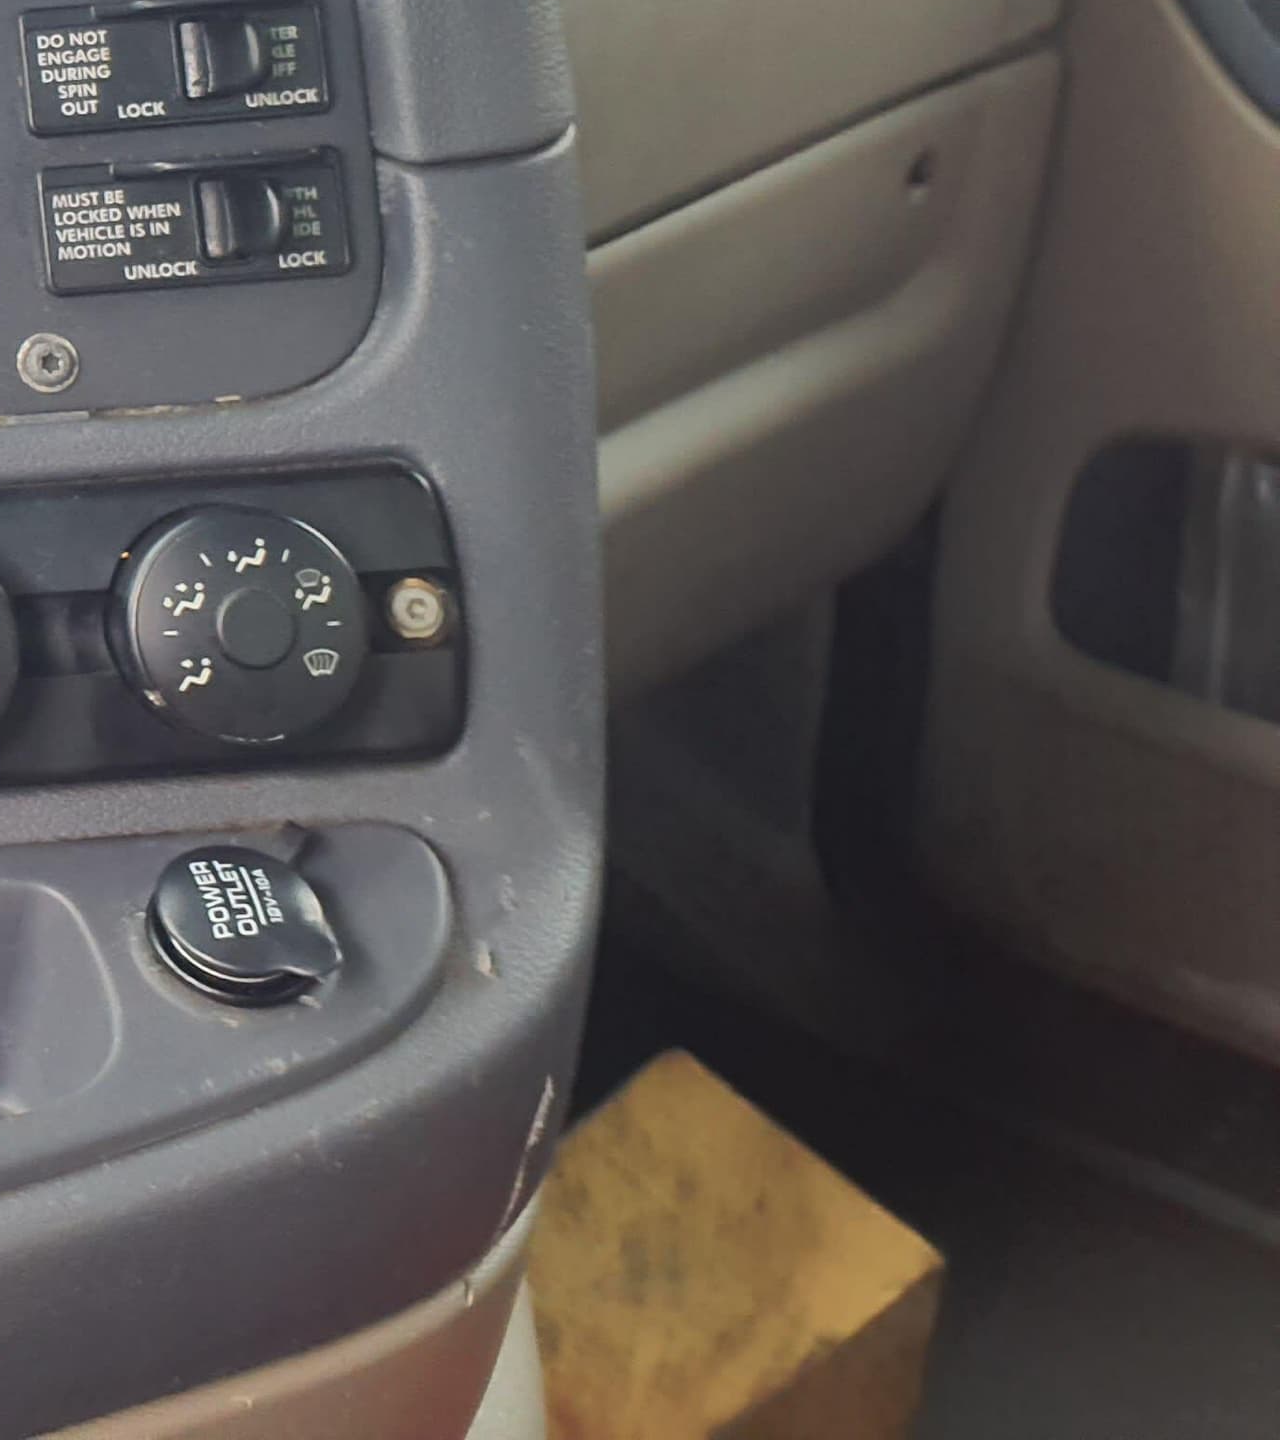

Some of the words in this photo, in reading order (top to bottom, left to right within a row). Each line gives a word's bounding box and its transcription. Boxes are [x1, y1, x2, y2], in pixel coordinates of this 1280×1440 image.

[37, 35, 64, 49] DO
[69, 30, 108, 45] NOT
[38, 47, 111, 66] ENGAGE
[41, 64, 111, 84] DURING
[58, 83, 97, 99] SPIN
[245, 88, 319, 108] UNLOCK
[61, 100, 99, 116] OUT
[117, 101, 165, 119] LOCK
[52, 192, 99, 209] MUST
[104, 190, 124, 205] BE
[54, 208, 122, 226] LOCKED
[126, 203, 181, 220] WHEN
[55, 224, 125, 243] VEHICLE
[130, 223, 146, 237] IS
[150, 221, 171, 236] IN
[58, 242, 132, 261] MOTION
[278, 251, 327, 269] LOCK
[123, 261, 199, 281] UNLOCK
[189, 861, 235, 939] POWER
[211, 860, 259, 936] OUTLET
